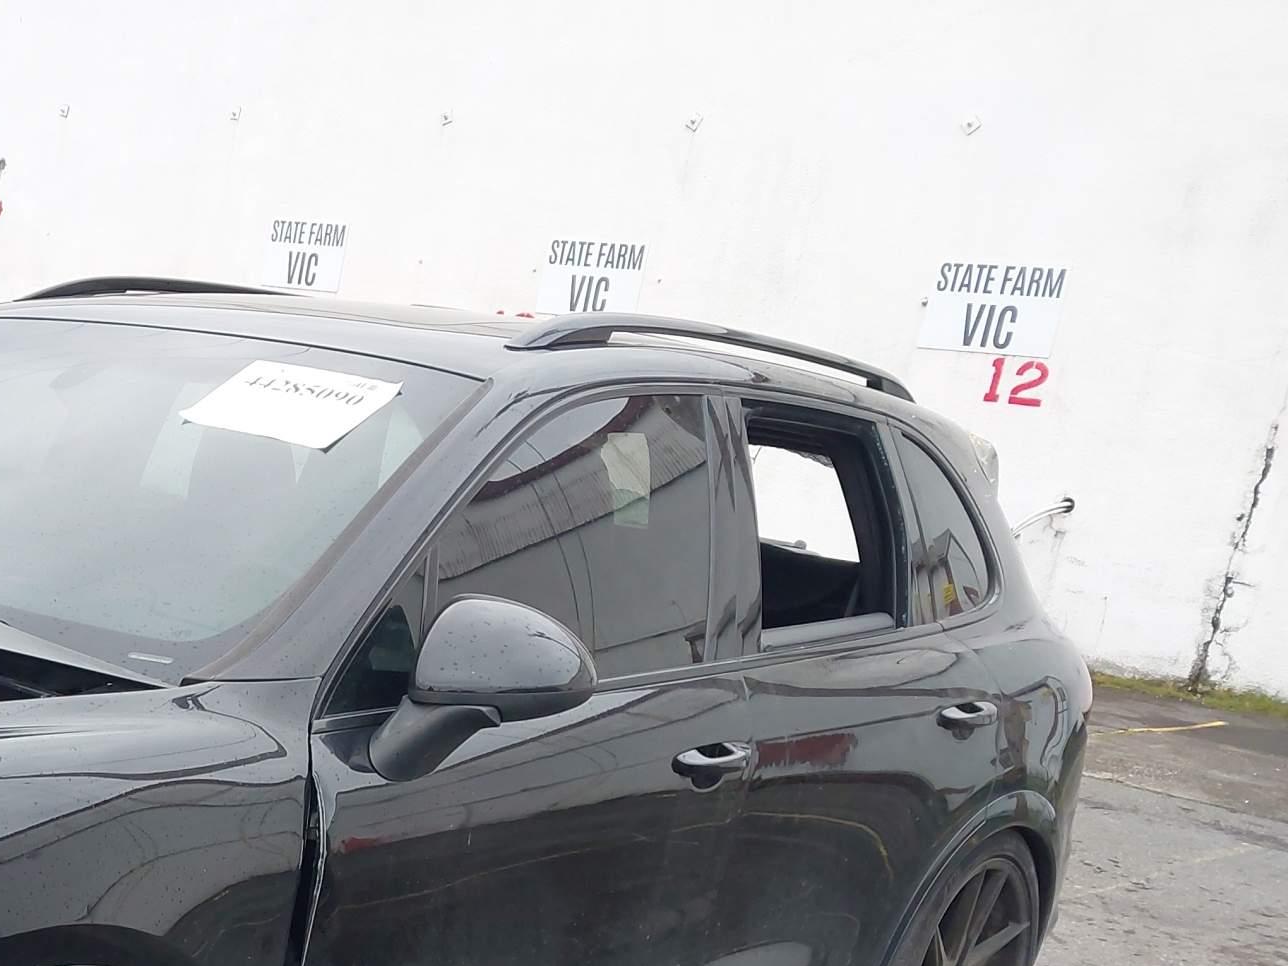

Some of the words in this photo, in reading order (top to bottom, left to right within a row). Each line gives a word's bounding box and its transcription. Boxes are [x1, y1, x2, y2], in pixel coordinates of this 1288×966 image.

[271, 219, 307, 244] STATE
[308, 222, 346, 247] FARM
[287, 250, 318, 286] VIC
[549, 239, 595, 267] STATE
[596, 242, 646, 271] FARM
[569, 274, 610, 312] VIC
[936, 262, 998, 294] STATE
[999, 265, 1067, 299] FARM
[962, 302, 1018, 349] VIC
[983, 357, 1049, 407] 12
